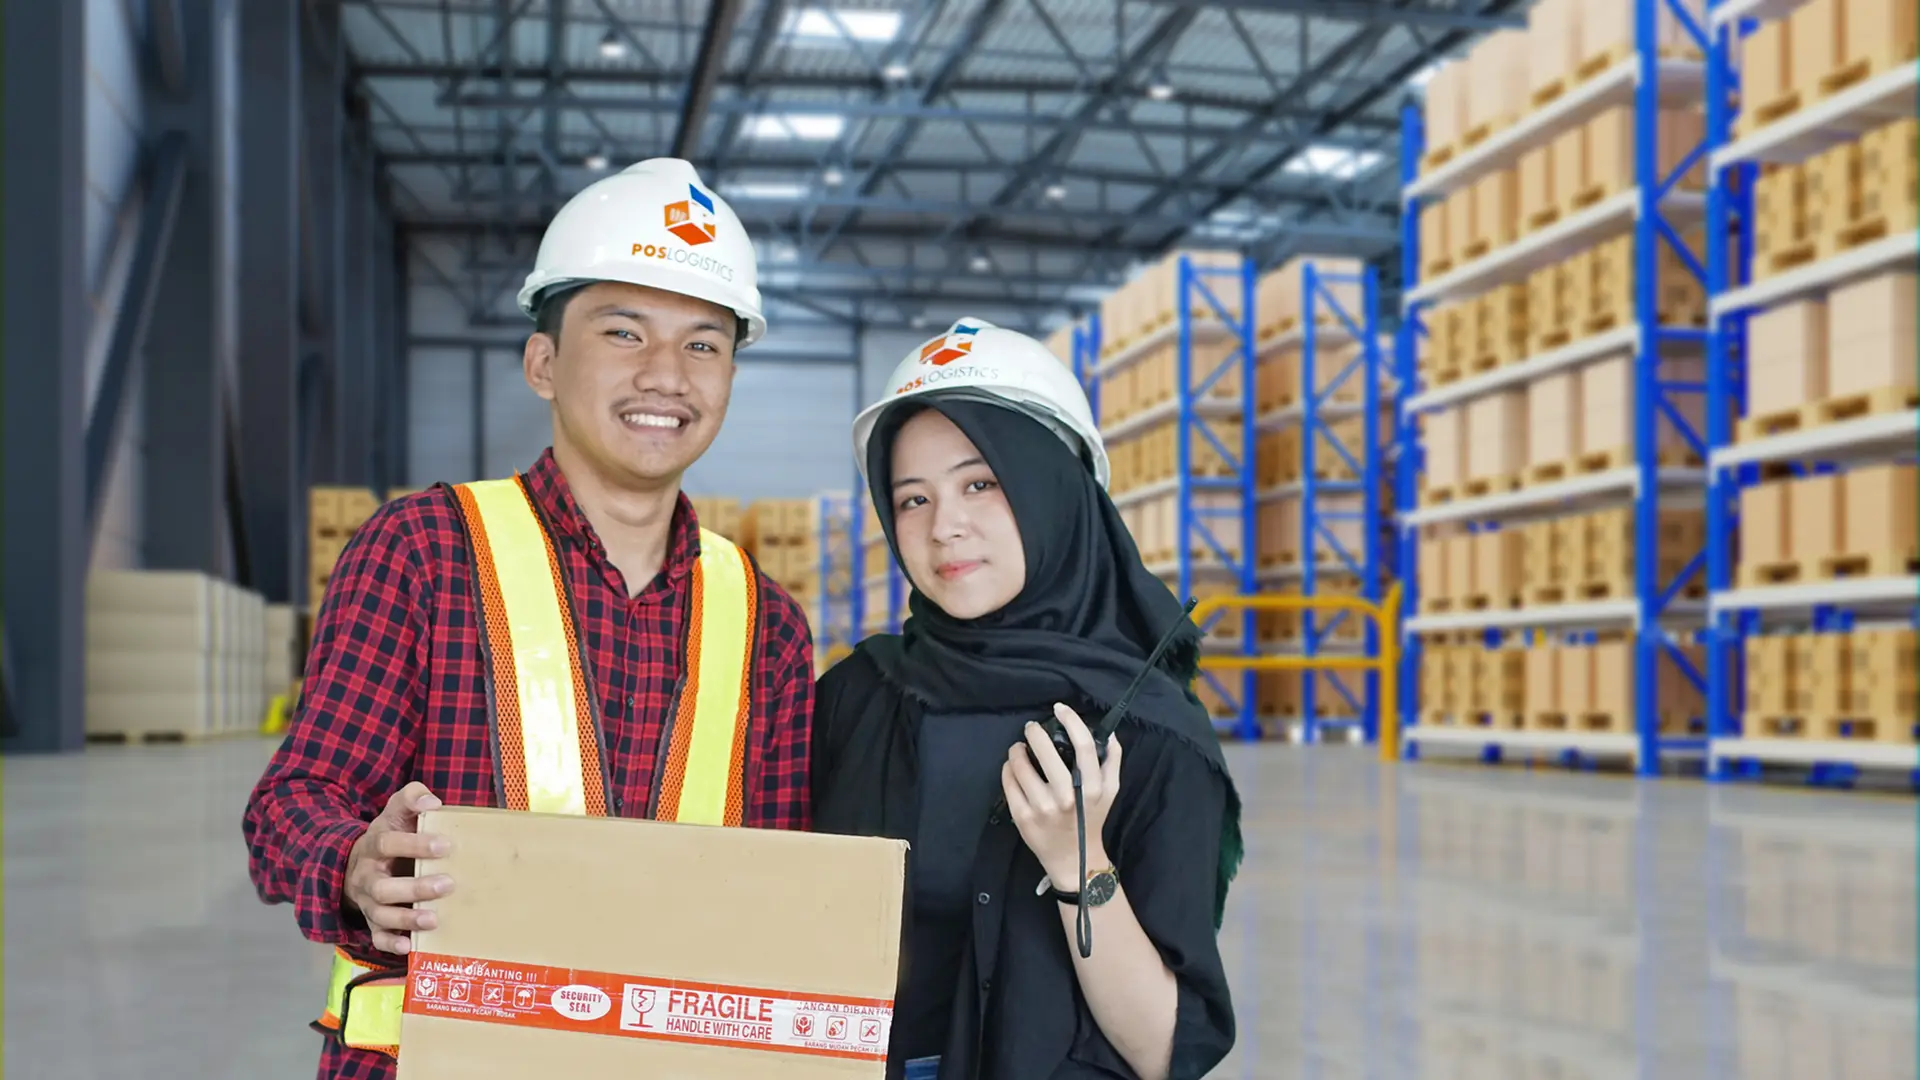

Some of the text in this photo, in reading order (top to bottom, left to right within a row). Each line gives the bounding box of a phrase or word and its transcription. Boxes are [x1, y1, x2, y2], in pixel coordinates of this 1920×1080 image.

[420, 961, 463, 973] JANGAN
[465, 966, 522, 981] DIBANTING
[526, 972, 537, 983] !!!
[560, 990, 603, 1003] SECURITY
[569, 1001, 591, 1013] SEAL
[667, 990, 774, 1022] FRAGILE
[797, 1002, 839, 1012] JANGAN
[666, 1017, 772, 1040] HANDLE WITH CARE
[804, 1041, 828, 1049] BARANG
